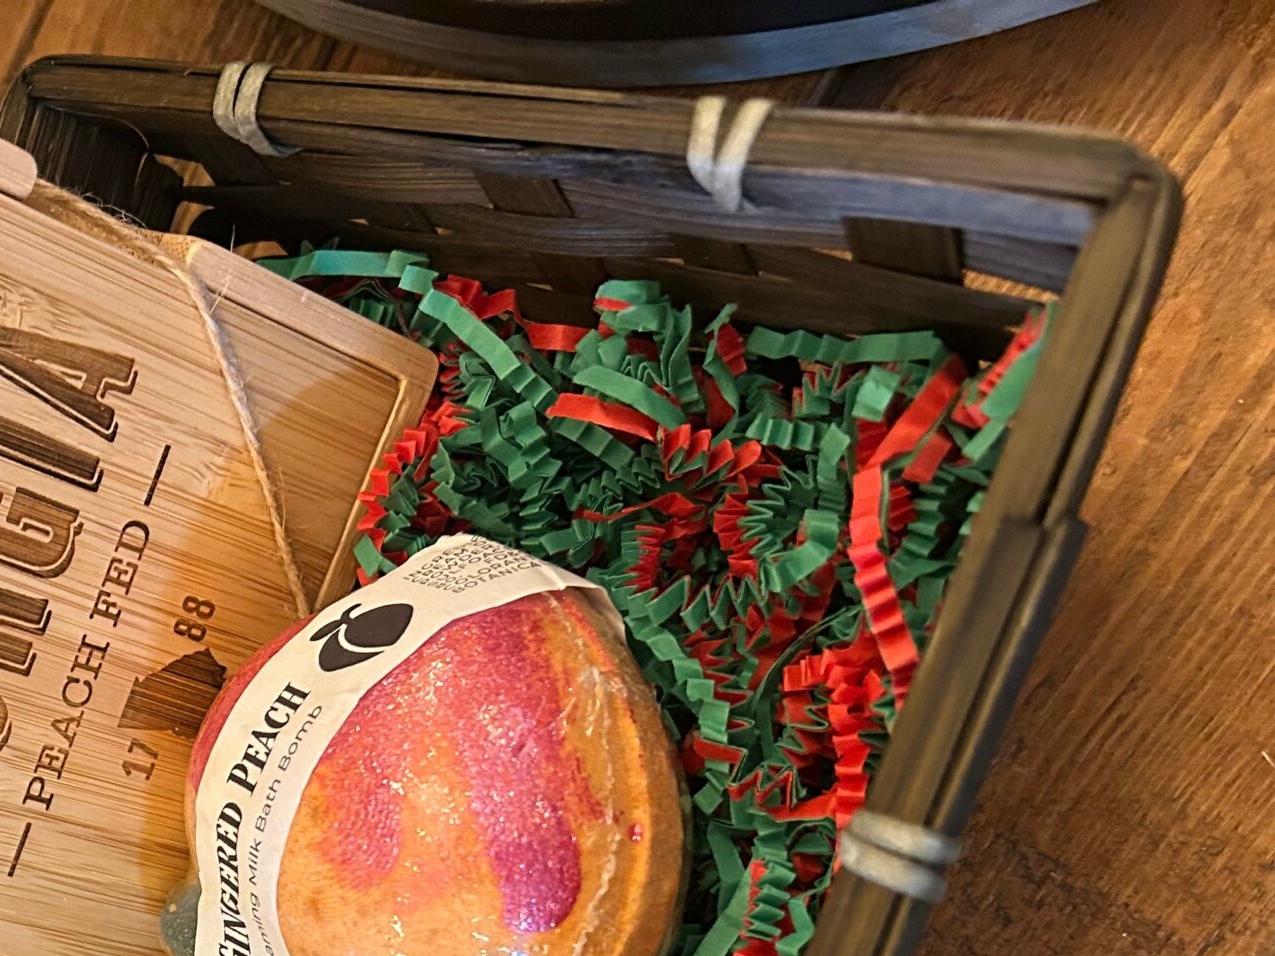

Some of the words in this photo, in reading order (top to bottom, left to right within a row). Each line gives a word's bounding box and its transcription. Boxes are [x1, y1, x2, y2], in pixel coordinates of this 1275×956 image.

[22, 632, 112, 811] PEACH
[89, 518, 150, 628] FED
[122, 738, 159, 781] 17
[173, 594, 216, 642] 88
[226, 681, 311, 797] PEACH
[278, 705, 323, 771] Bomb
[255, 778, 282, 833] Bath
[249, 838, 262, 886] Milk
